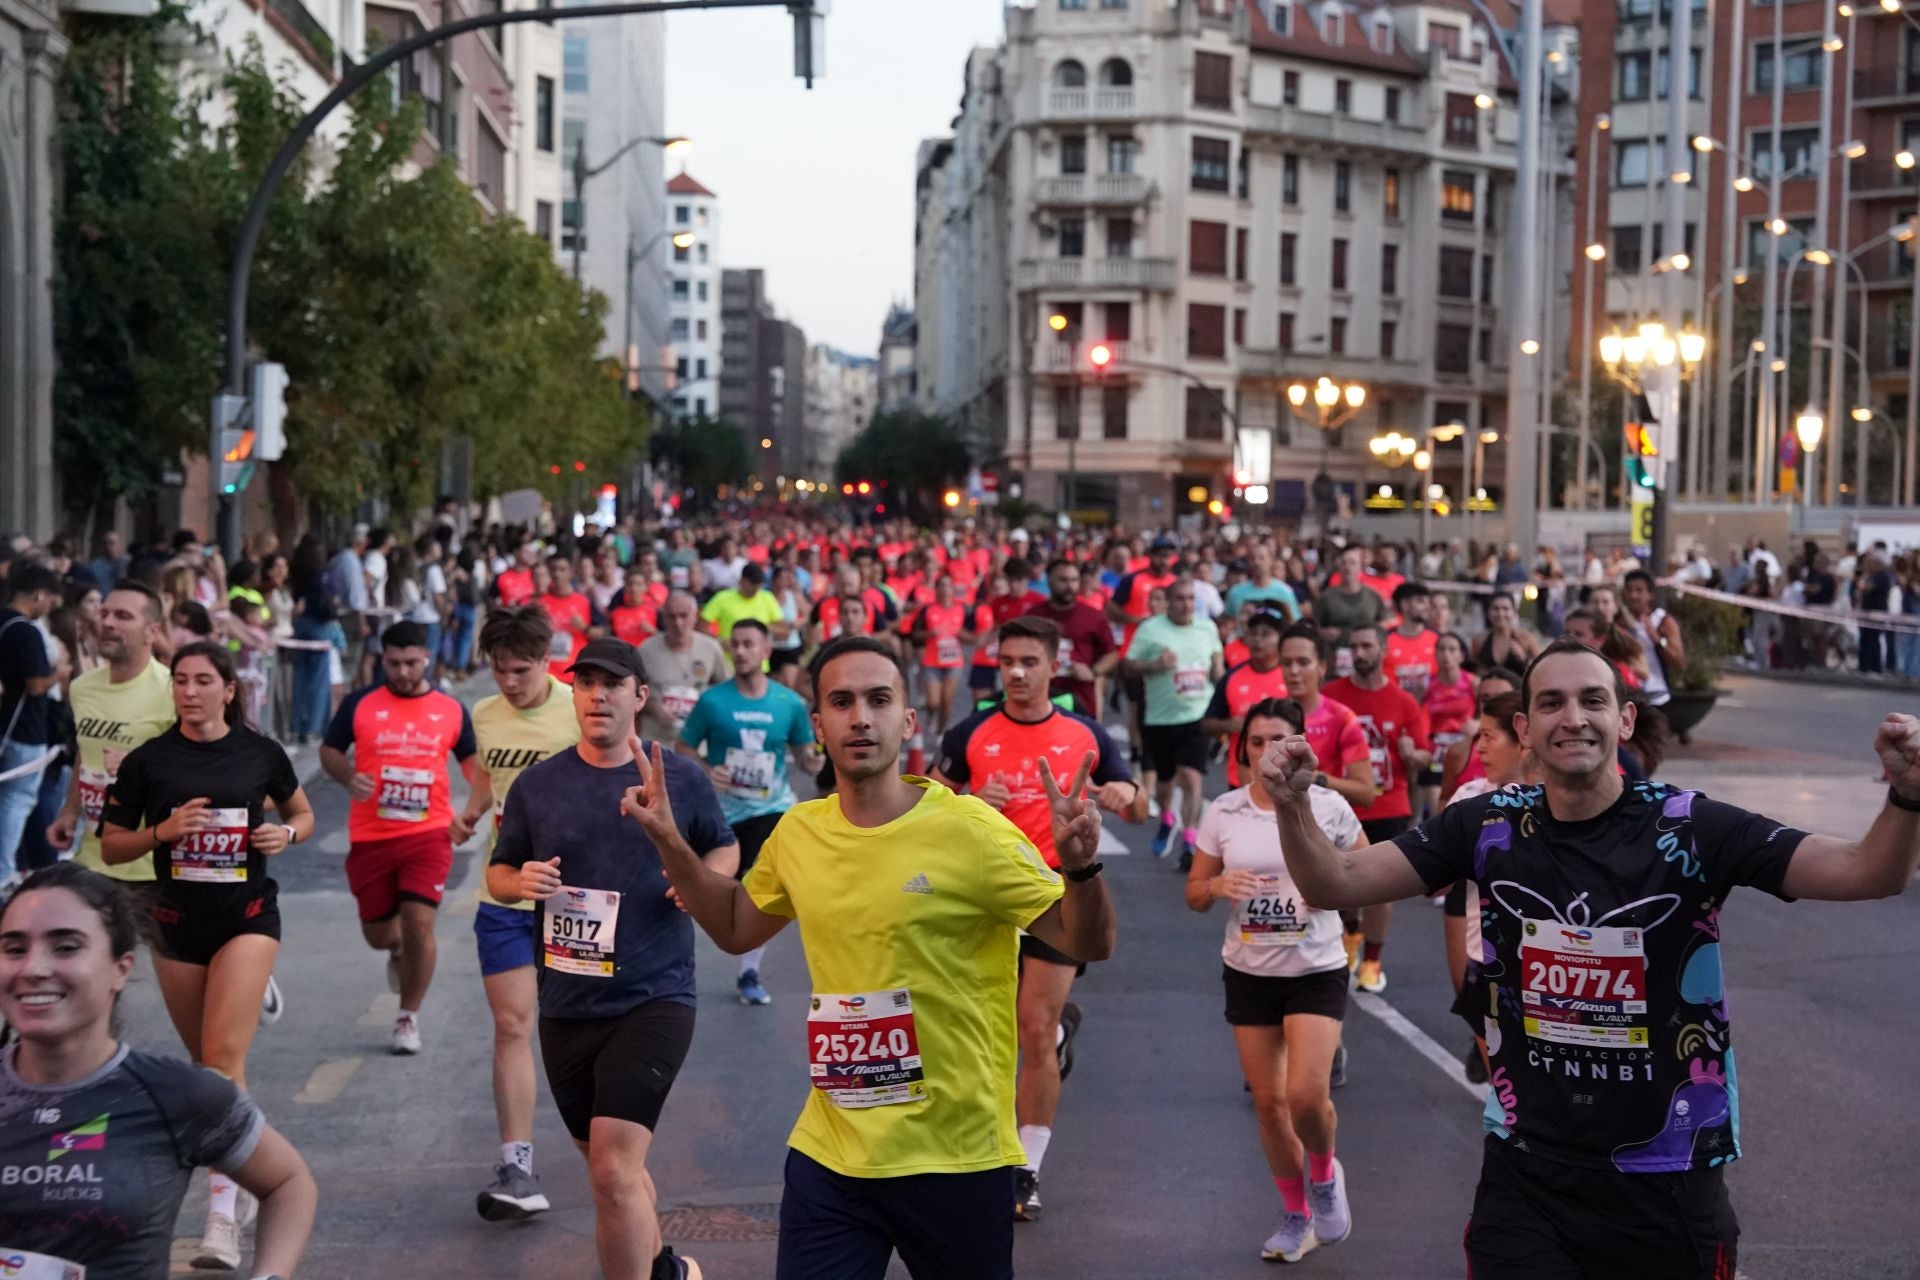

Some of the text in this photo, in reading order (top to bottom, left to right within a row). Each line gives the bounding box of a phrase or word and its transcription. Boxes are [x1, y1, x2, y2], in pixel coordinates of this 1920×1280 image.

[176, 832, 243, 853] 21997
[1247, 898, 1296, 916] 4266
[552, 914, 602, 941] 5017
[1554, 953, 1602, 965] NOVIOPITU
[1529, 961, 1637, 999] 20774
[840, 1022, 869, 1031] AITANA
[814, 1028, 910, 1063] 25240
[1634, 1032, 1643, 1042] 3
[2, 1164, 103, 1185] BORAL
[43, 1187, 103, 1201] kutxa
